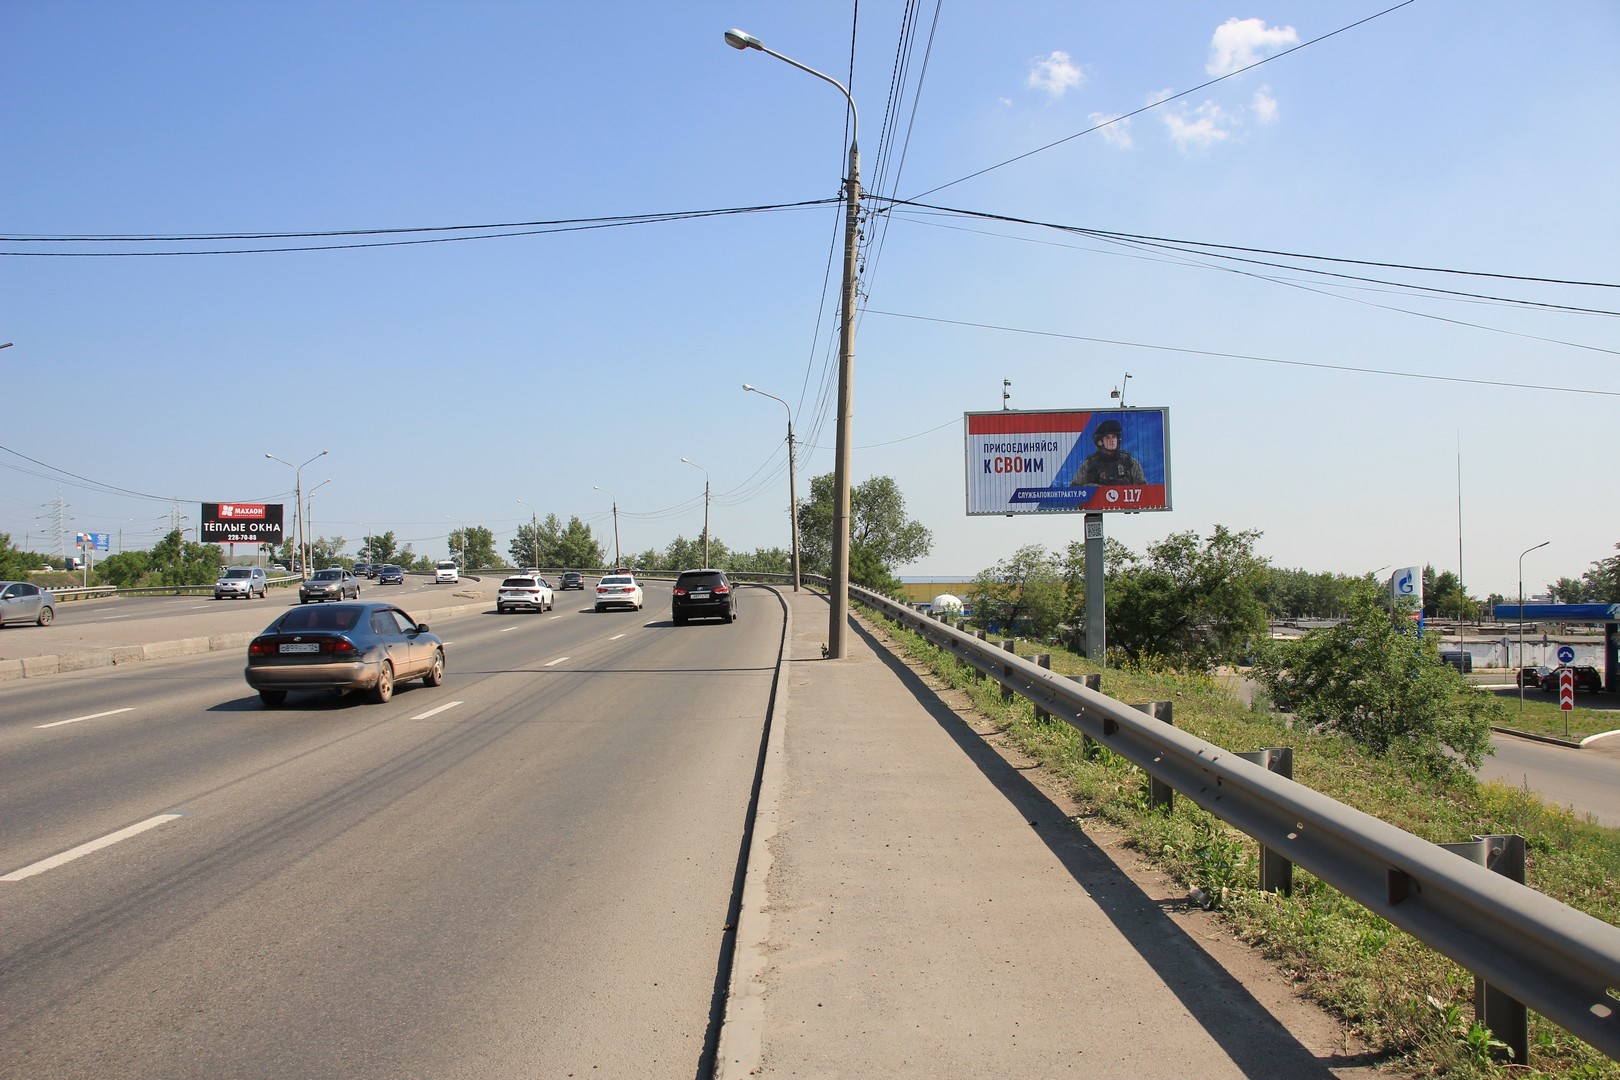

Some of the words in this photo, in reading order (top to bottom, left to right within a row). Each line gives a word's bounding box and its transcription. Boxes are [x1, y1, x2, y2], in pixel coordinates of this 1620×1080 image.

[983, 441, 1058, 454] ПРИСОЕДИНЯЙСЯ
[984, 459, 992, 474] К
[994, 456, 1044, 474] СВОИМ
[1017, 490, 1087, 500] СЛУЖБАПОКОНТРАКТУ.РФ
[1123, 489, 1141, 503] 117
[234, 507, 263, 515] МАХАОН
[249, 522, 281, 532] ОКНА
